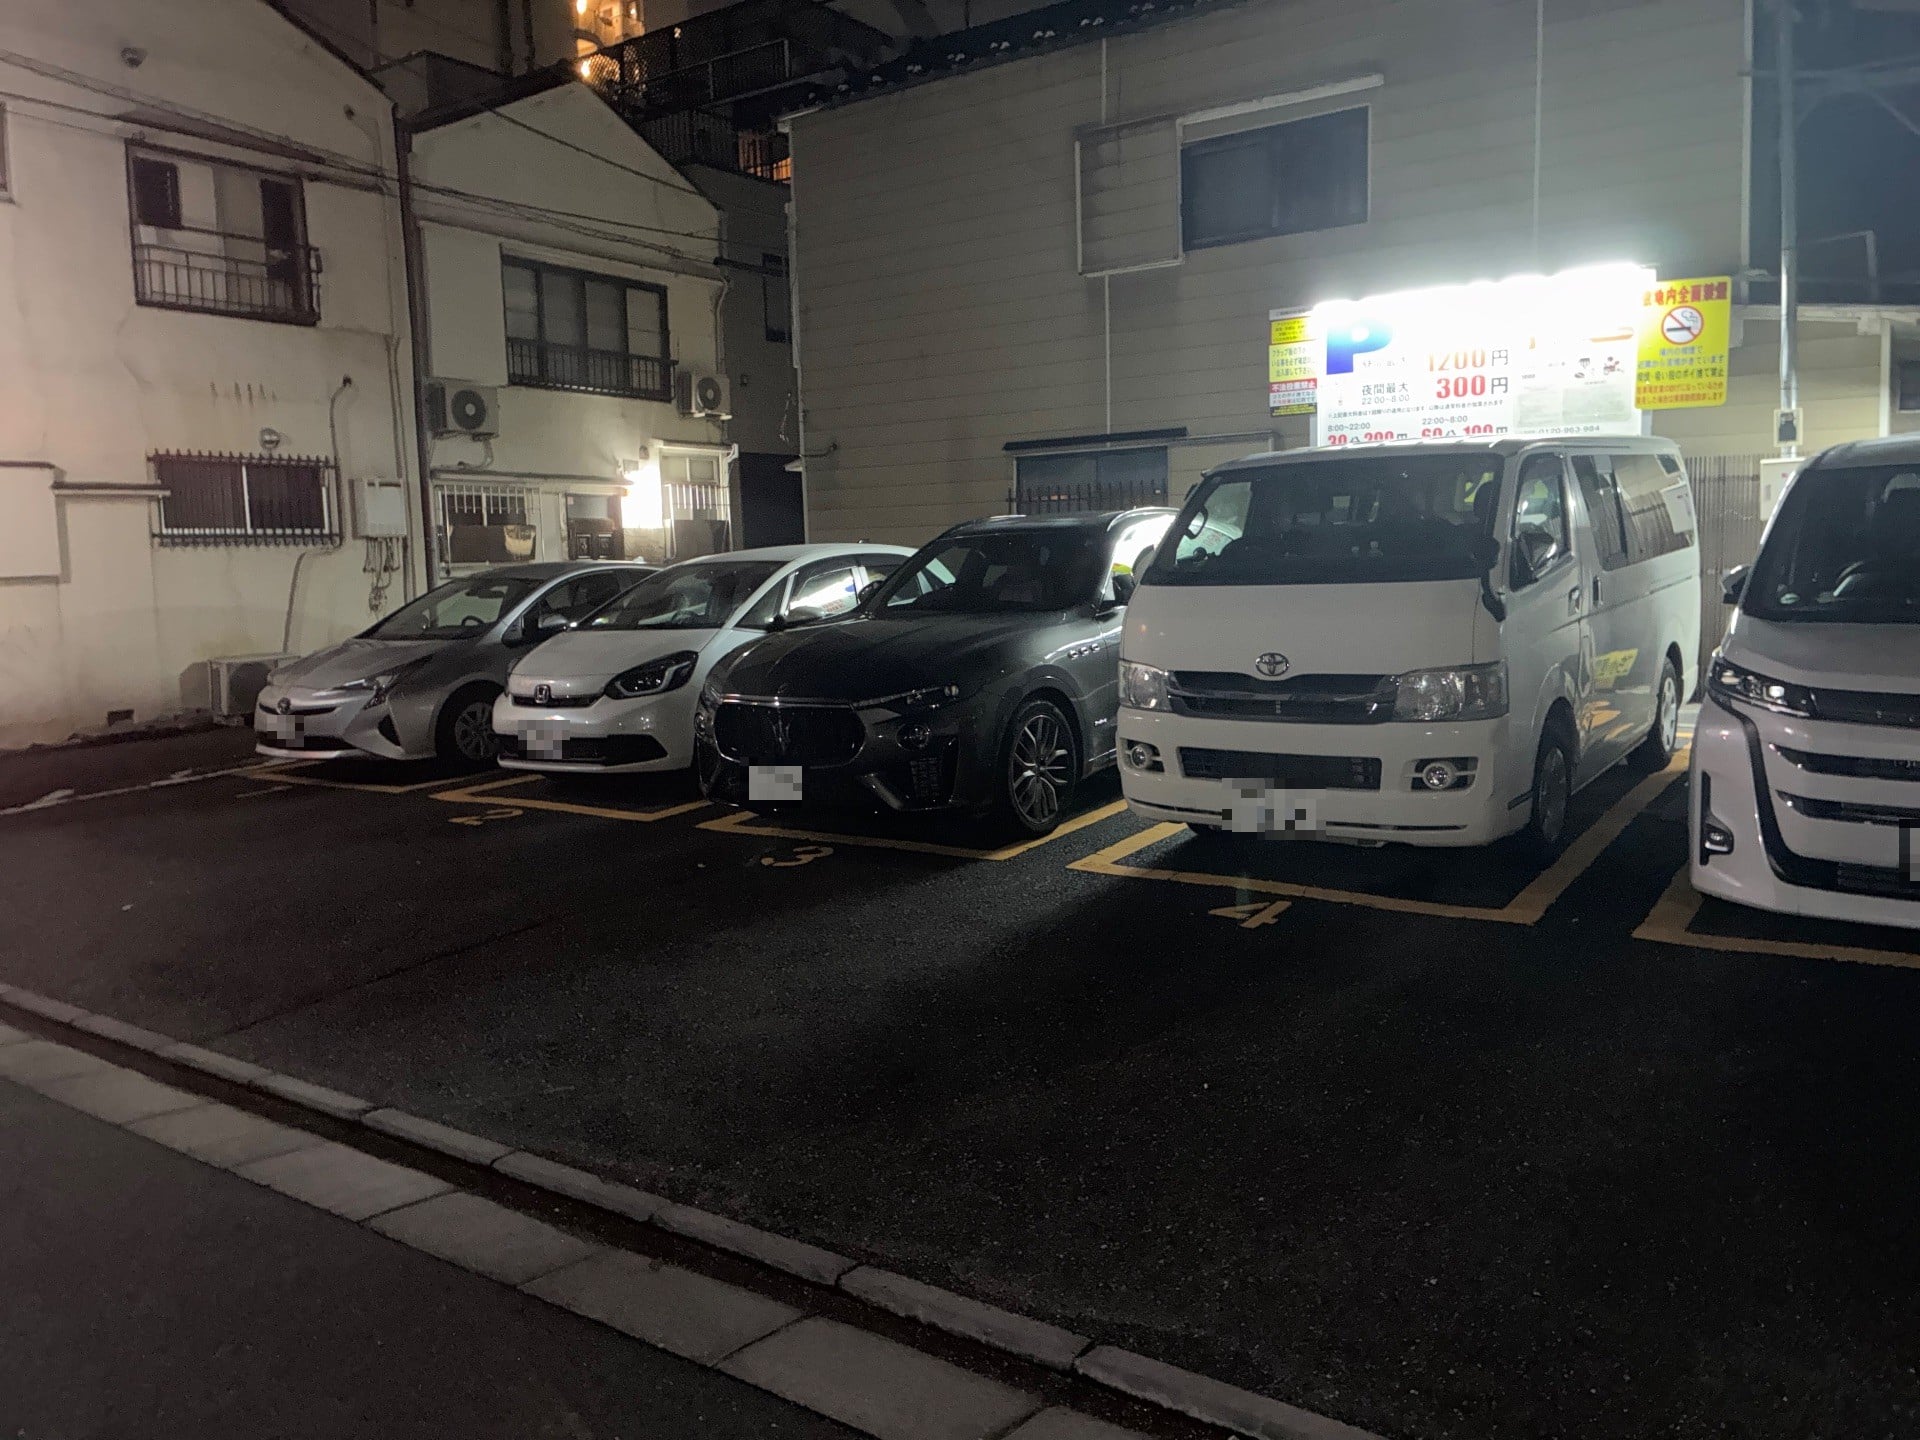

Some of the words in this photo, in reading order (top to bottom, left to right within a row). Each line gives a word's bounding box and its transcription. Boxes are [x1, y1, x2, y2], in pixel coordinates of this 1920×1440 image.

[1362, 382, 1409, 396] 夜間最大
[1436, 375, 1509, 399] 300円
[761, 846, 834, 867] 3
[1208, 900, 1292, 929] 4
